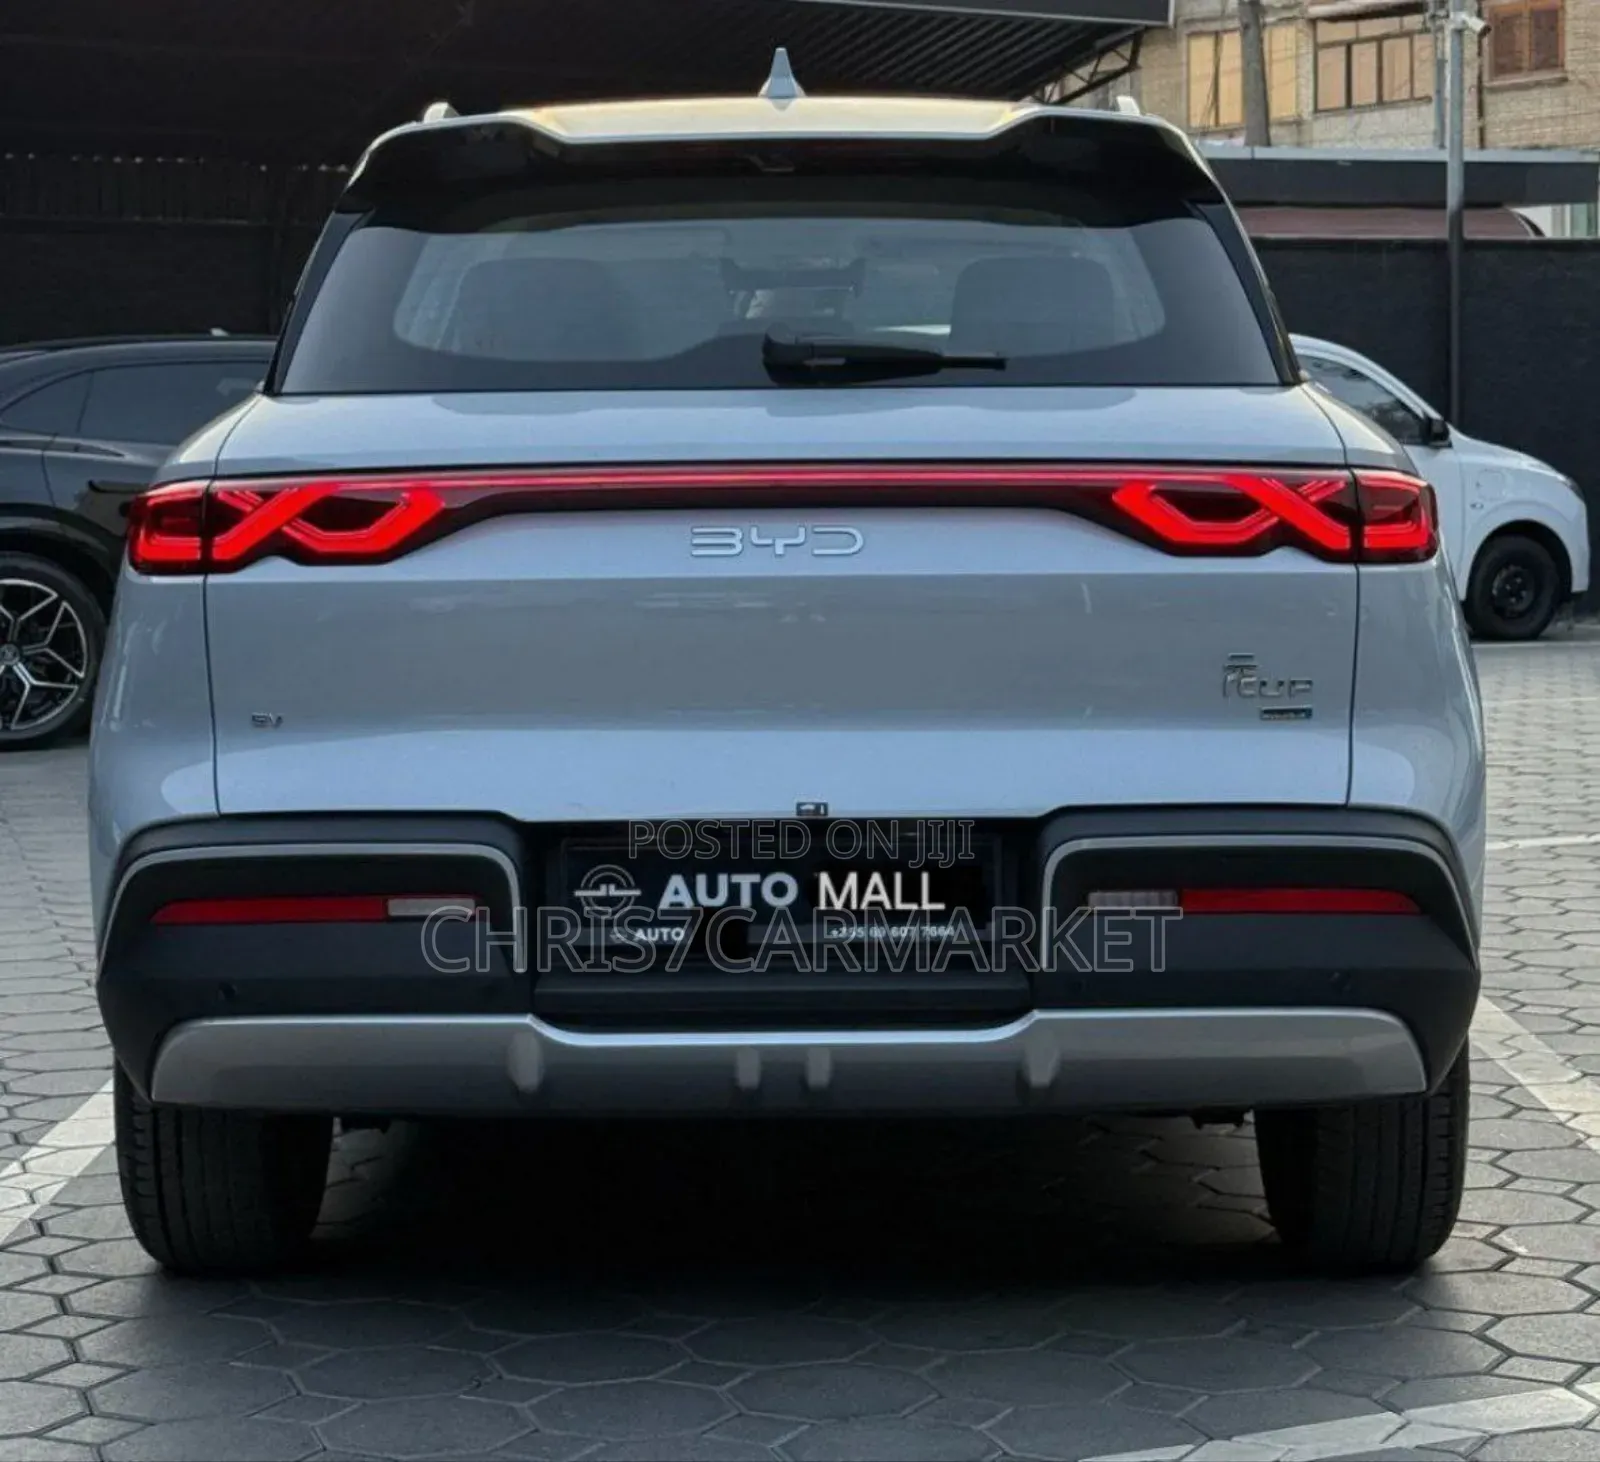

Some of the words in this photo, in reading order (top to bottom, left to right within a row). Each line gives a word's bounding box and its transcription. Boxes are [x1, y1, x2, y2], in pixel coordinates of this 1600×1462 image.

[691, 526, 864, 556] BYD
[658, 873, 798, 910] AUTO
[817, 871, 946, 911] MALL
[632, 926, 685, 941] AUTO
